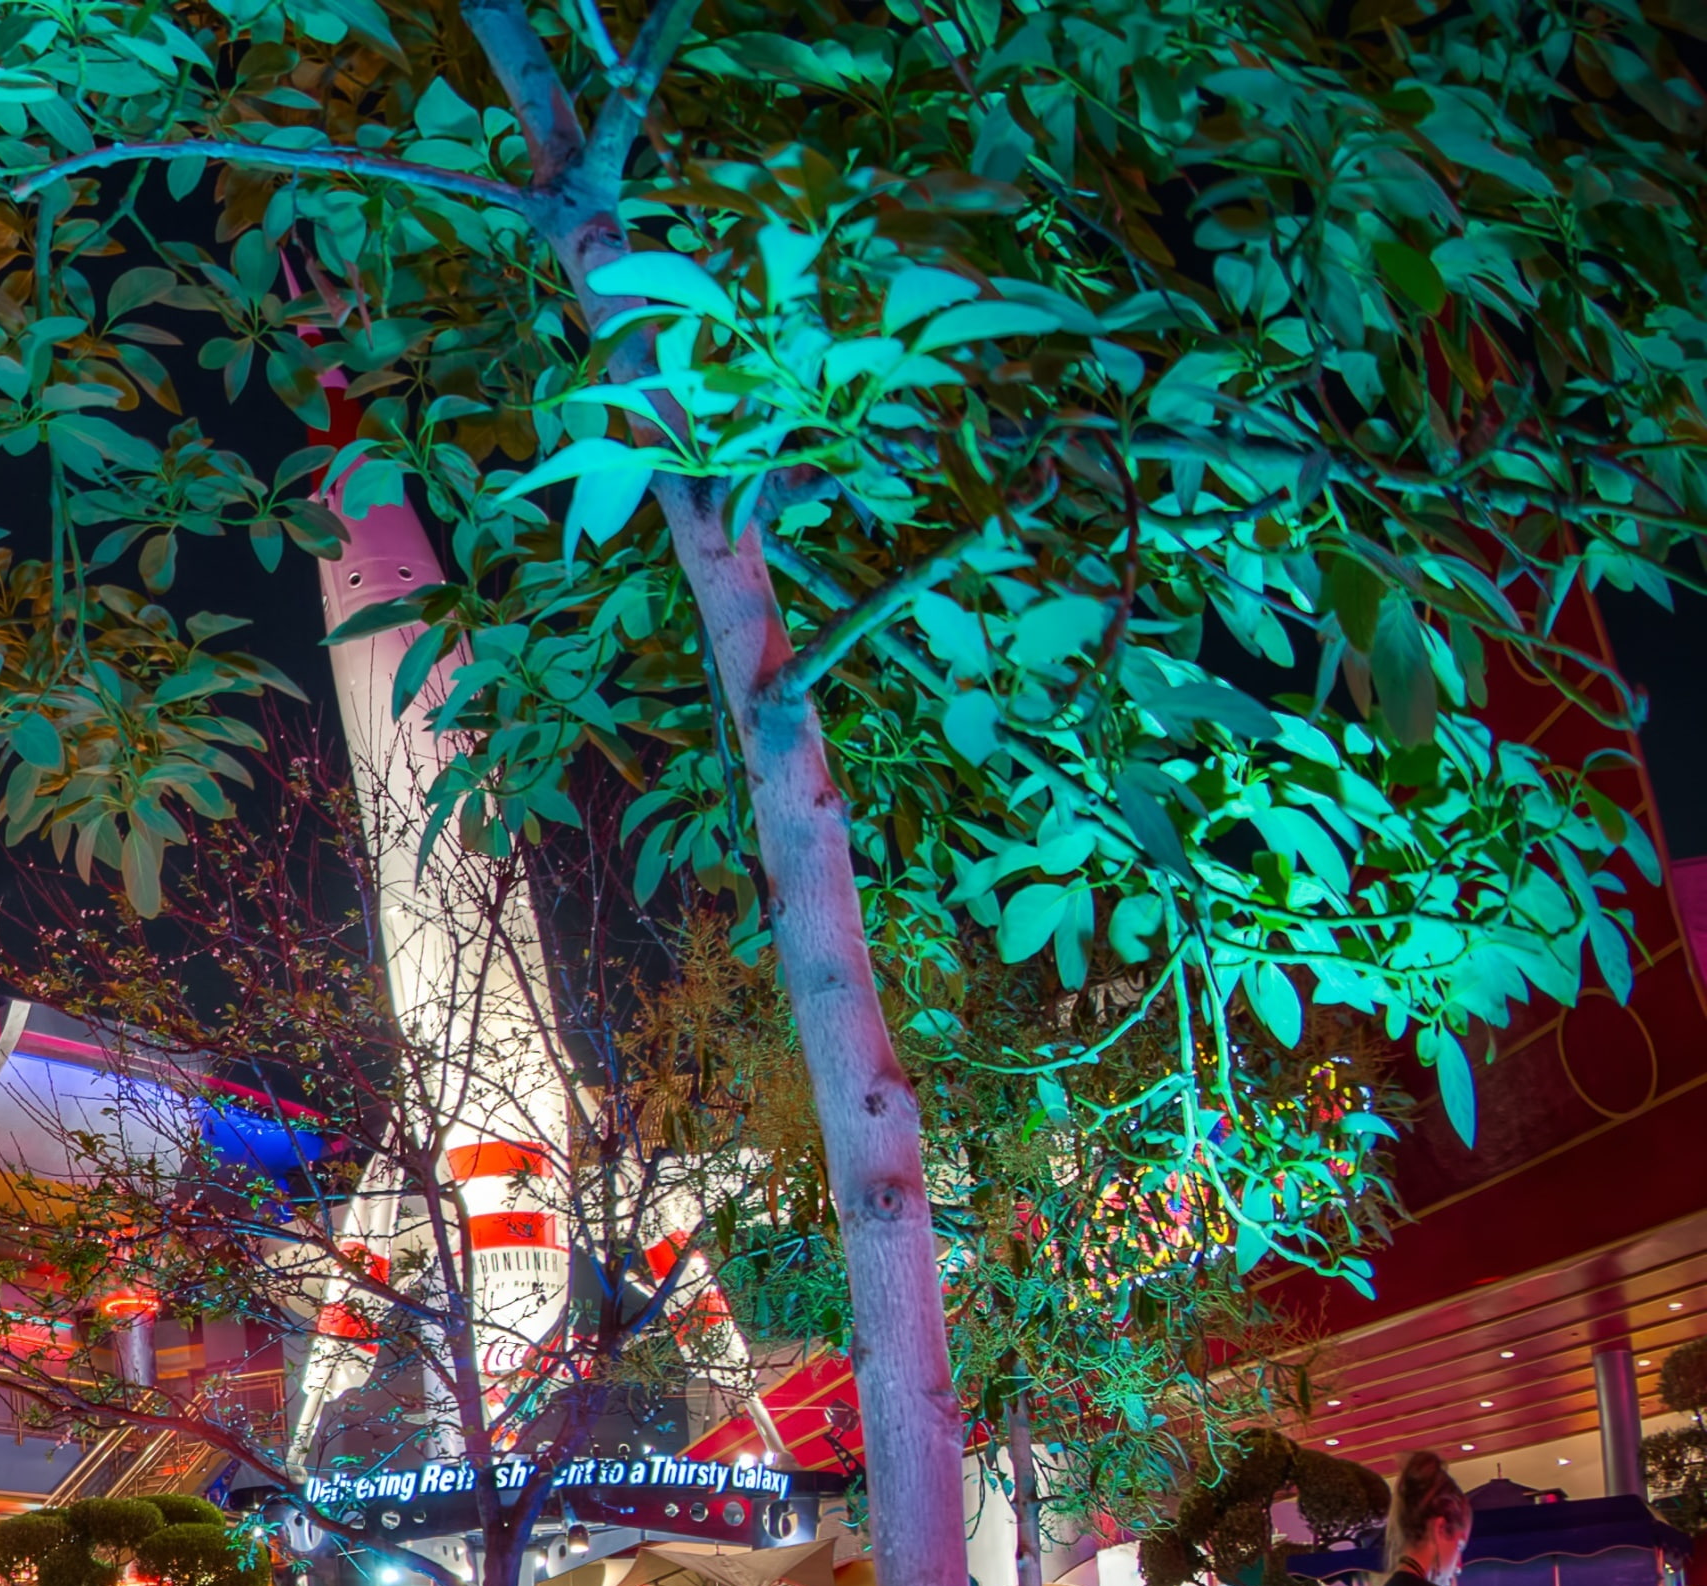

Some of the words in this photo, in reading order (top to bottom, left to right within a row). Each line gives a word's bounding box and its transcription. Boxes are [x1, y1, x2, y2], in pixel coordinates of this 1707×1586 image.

[472, 1251, 558, 1274] OONLINER
[420, 1459, 597, 1494] Refrshnt
[599, 1459, 625, 1485] to
[630, 1462, 646, 1485] a
[650, 1455, 730, 1493] Thirsty
[732, 1460, 789, 1499] Galaxy
